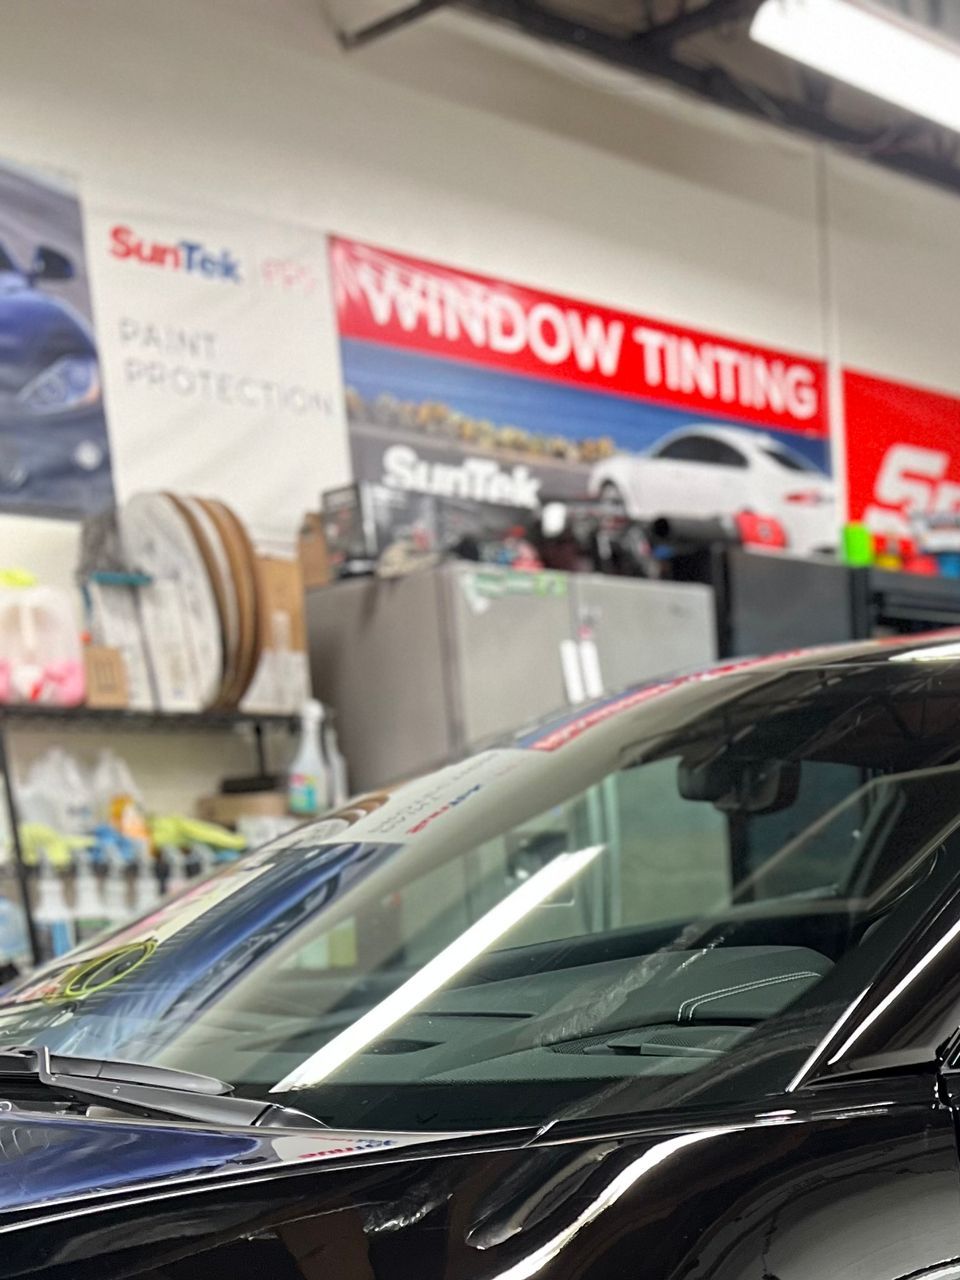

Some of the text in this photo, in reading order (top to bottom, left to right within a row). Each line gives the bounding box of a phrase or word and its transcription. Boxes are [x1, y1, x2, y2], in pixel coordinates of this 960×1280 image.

[109, 224, 242, 284] SunTek
[118, 316, 217, 359] PAINT
[123, 357, 334, 416] PROTECTION
[635, 329, 818, 419] TINTING
[382, 443, 541, 508] SunTek
